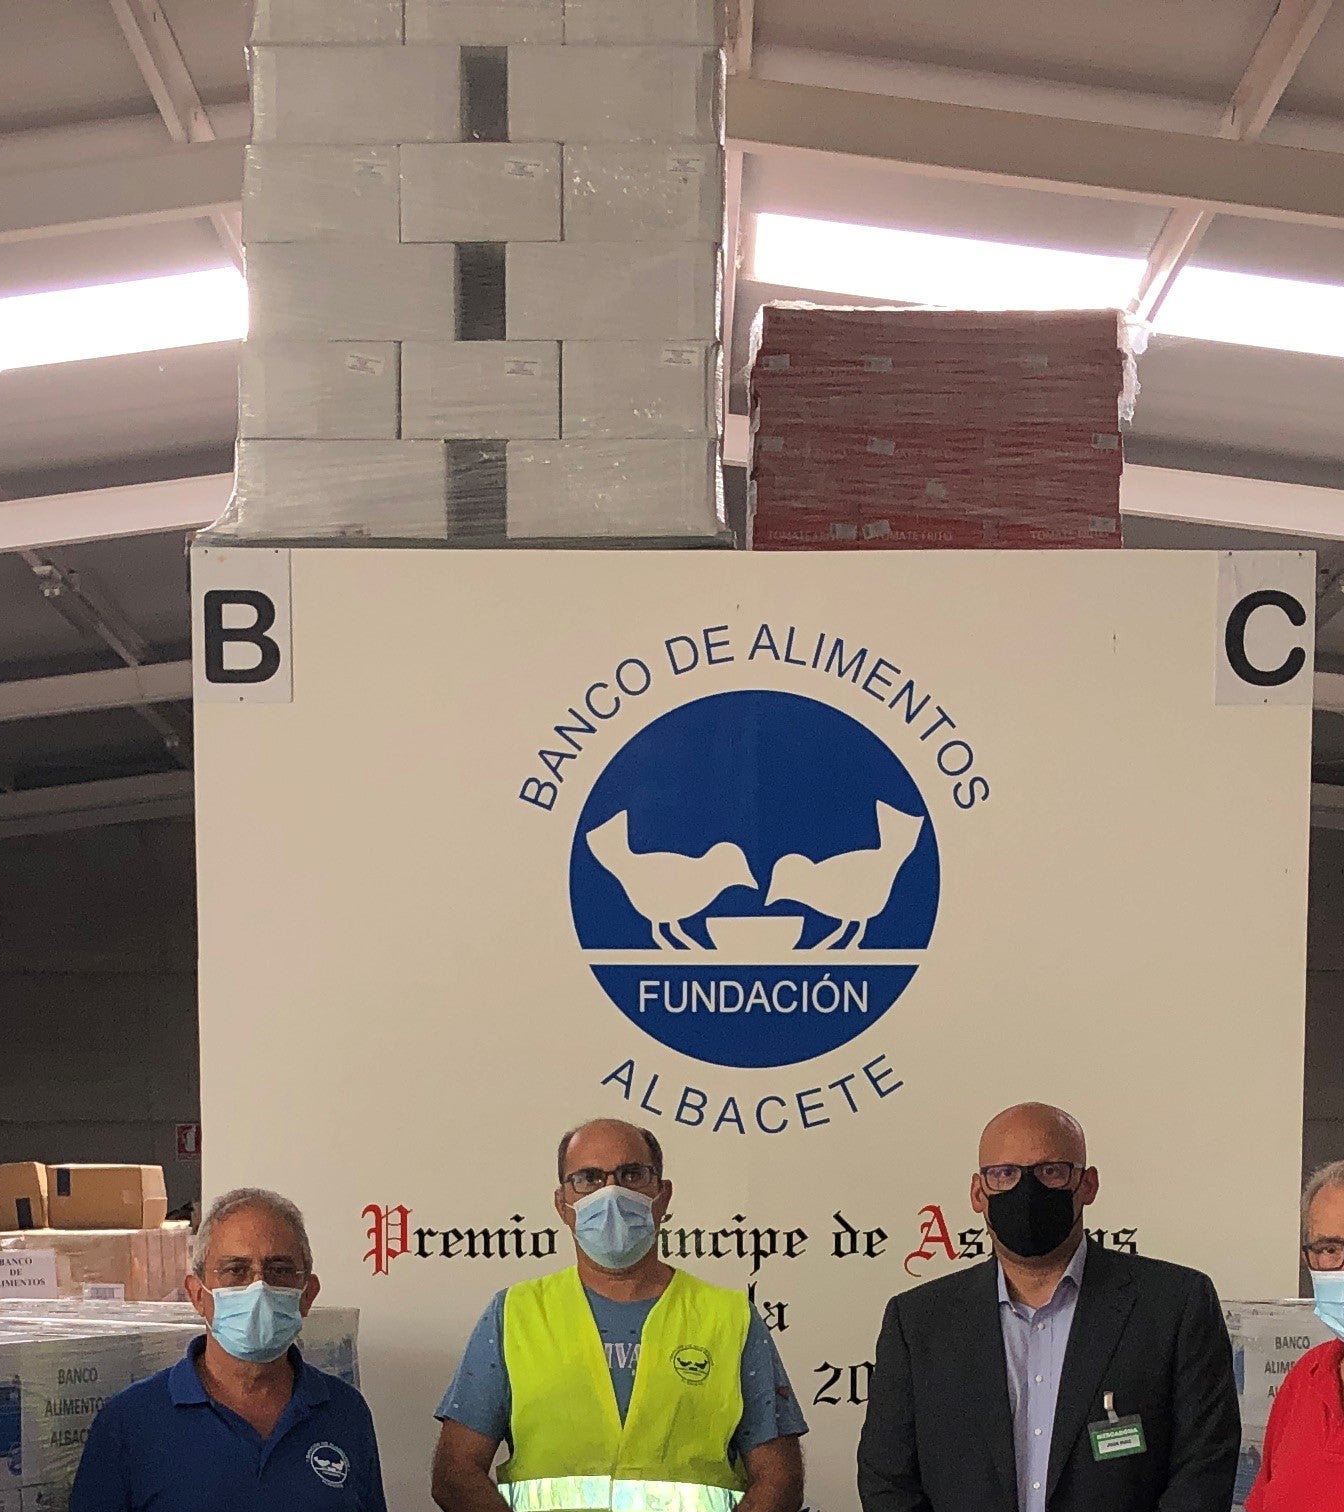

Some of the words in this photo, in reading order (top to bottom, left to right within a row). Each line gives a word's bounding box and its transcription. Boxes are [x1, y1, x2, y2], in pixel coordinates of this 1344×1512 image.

[203, 589, 281, 684] B
[1225, 589, 1307, 687] C
[519, 658, 651, 811] BANCO
[665, 625, 734, 675] DE
[748, 623, 990, 809] ALIMENTOS
[637, 972, 869, 1014] FUNDACIÓN
[601, 1054, 904, 1135] ALBACETE
[361, 1204, 557, 1276] Premio
[660, 1209, 808, 1275] íncipe
[830, 1211, 888, 1258] de
[10, 1268, 23, 1276] DE
[1275, 1335, 1310, 1350] BANCO
[58, 1367, 98, 1384] BANCO
[45, 1397, 111, 1416] ALIMENTO
